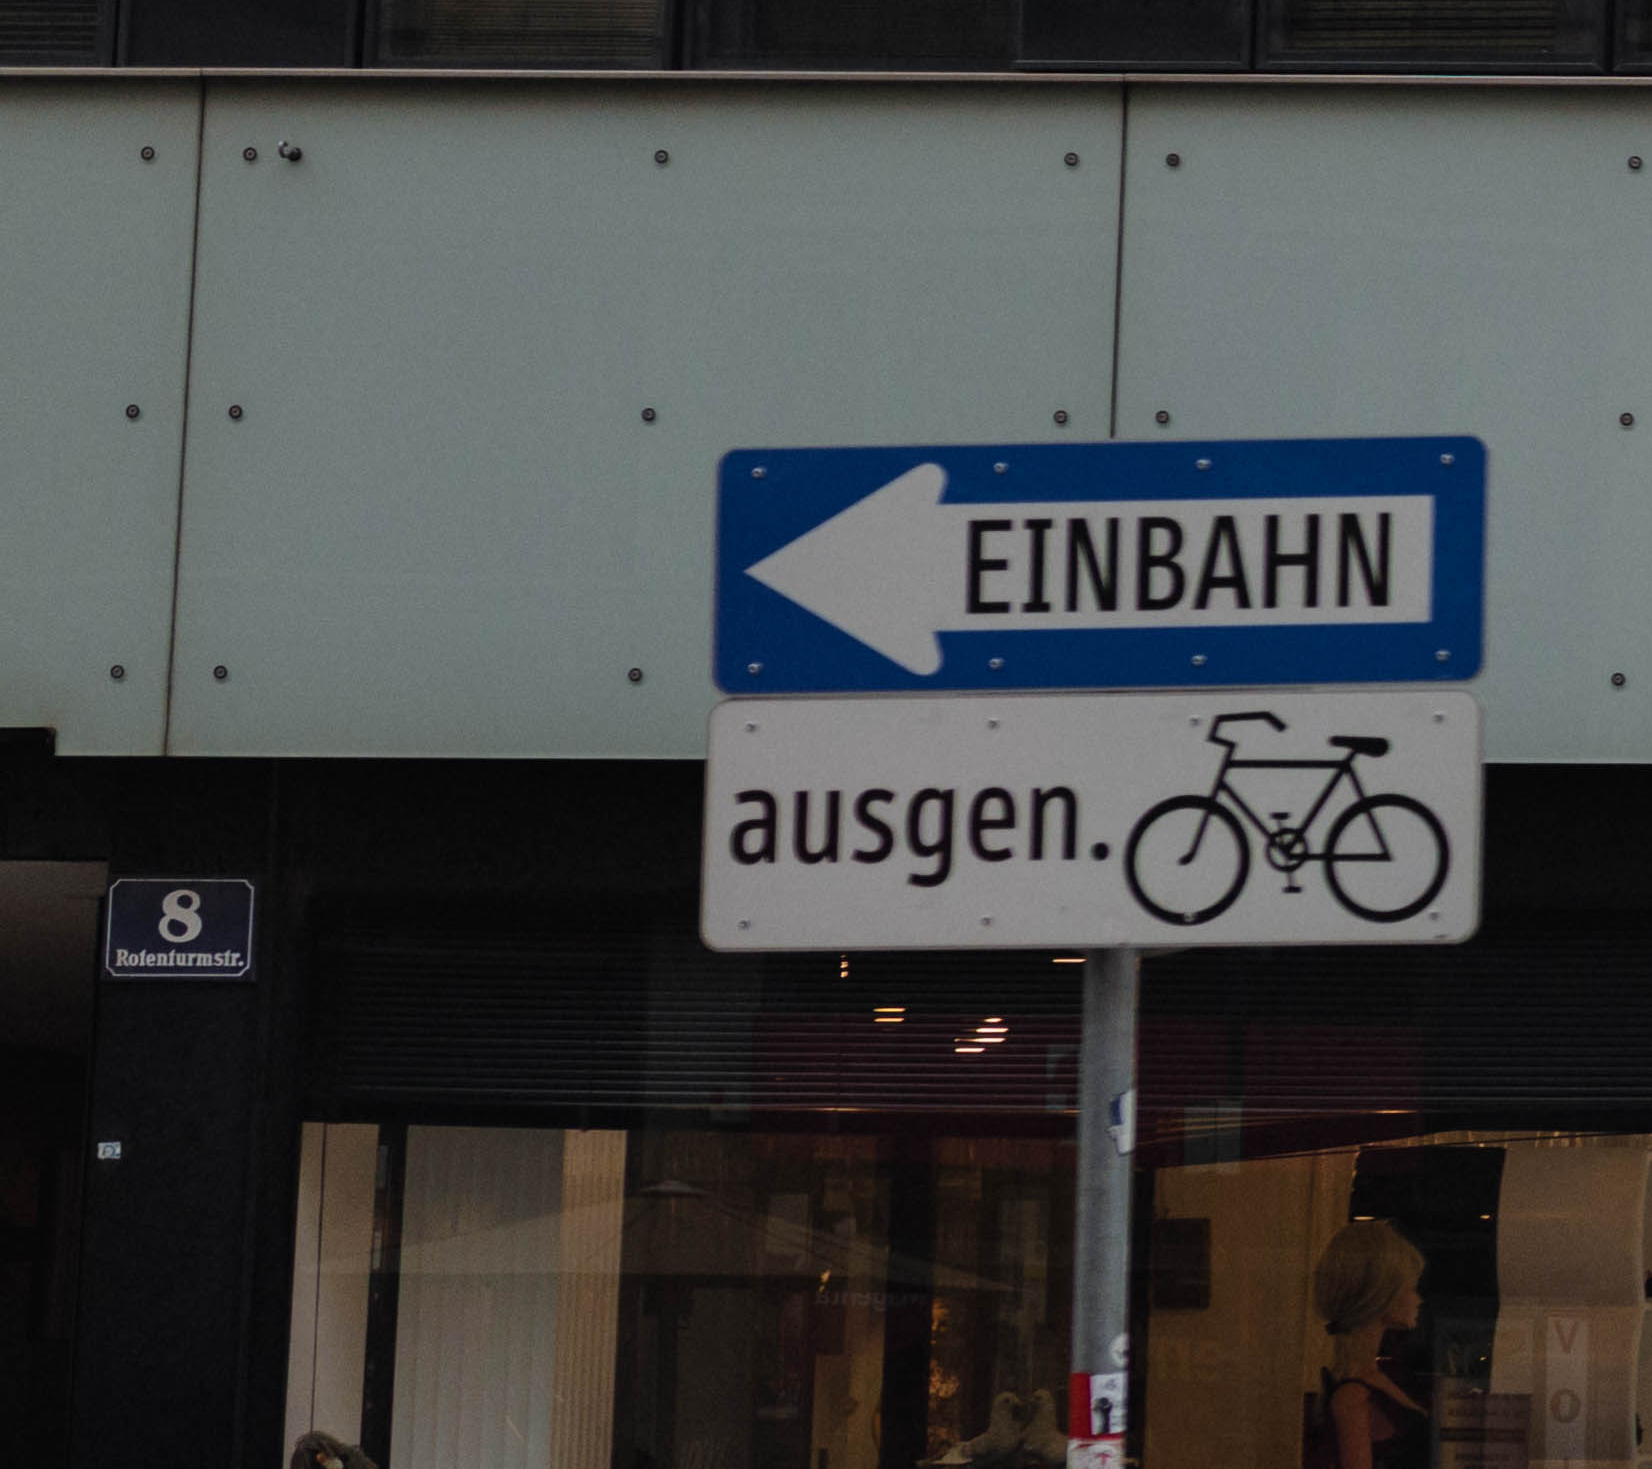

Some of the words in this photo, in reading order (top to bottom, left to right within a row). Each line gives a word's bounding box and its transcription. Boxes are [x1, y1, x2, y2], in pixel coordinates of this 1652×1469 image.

[965, 511, 1394, 616] EINBAHN
[730, 785, 1111, 888] ausgen.
[158, 889, 203, 944] 8
[115, 949, 245, 968] Rotenturmstr.
